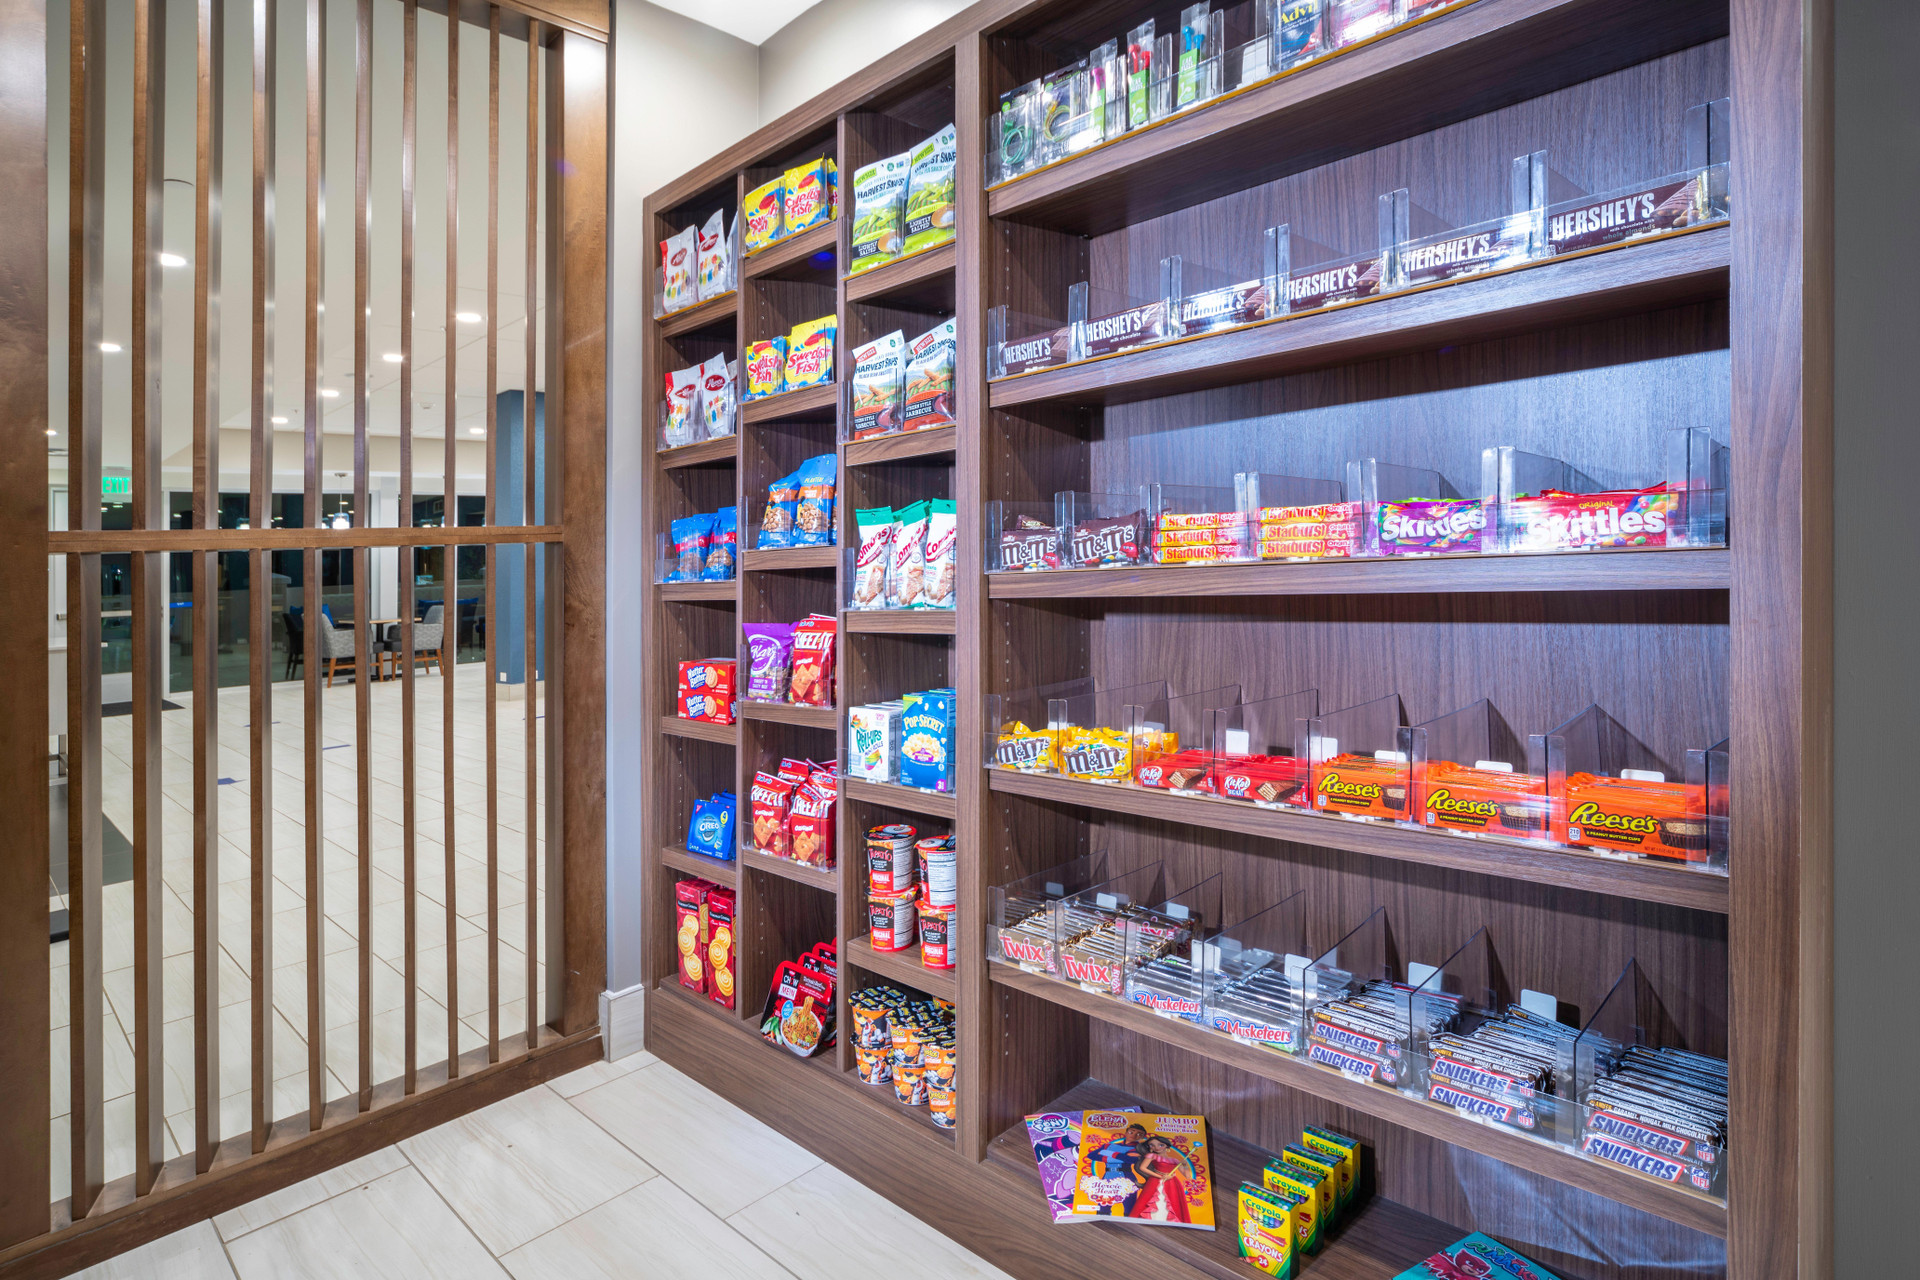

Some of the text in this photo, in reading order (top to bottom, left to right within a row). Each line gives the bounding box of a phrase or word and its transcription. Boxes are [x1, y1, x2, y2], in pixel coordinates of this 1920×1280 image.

[857, 182, 886, 198] HARVEST
[1552, 192, 1655, 240] HERSHEY'S
[1621, 221, 1643, 230] chocolate
[1602, 224, 1656, 241] whole almonds
[1404, 234, 1490, 272] HERSHEY'S
[1285, 266, 1357, 300] HERSHEY'S
[1086, 310, 1142, 342] HERSHEY'S
[1005, 338, 1050, 364] HERSHEY'S
[796, 360, 820, 375] Fish
[857, 360, 885, 374] HARVEST
[103, 477, 129, 493] EXIT
[1267, 524, 1326, 538] Starburst
[1380, 509, 1487, 542] Skittles
[1526, 508, 1666, 546] Skittles
[1166, 530, 1216, 544] Starburst
[1266, 540, 1325, 554] Starburst
[1166, 545, 1216, 559] Starburst
[687, 666, 705, 678] Nutter
[690, 674, 706, 689] Butter
[686, 695, 703, 707] Nutter
[689, 702, 706, 717] Butter
[872, 741, 884, 750] ROLLS
[1318, 773, 1382, 798] Reese's
[1427, 789, 1499, 816] Reese's
[700, 822, 719, 831] OREO
[1569, 802, 1658, 833] Reese's
[1000, 936, 1045, 963] Twix
[1063, 954, 1110, 984] Twix
[781, 986, 795, 997] MEIN
[1136, 992, 1145, 1004] 3
[1215, 1019, 1291, 1042] 3 Musketeers
[1316, 1024, 1378, 1053] SNICKERS
[1311, 1046, 1396, 1081] SNICKERS NFL
[1435, 1060, 1534, 1096] SNICKERS NFL
[1432, 1087, 1533, 1126] SNICKERS NFL
[1091, 1114, 1124, 1123] ELENA
[1613, 1107, 1708, 1141] CARAMEL, NOUGAT, MILK CHOCOLATE
[1310, 1139, 1344, 1157] Crayola
[1592, 1114, 1715, 1162] SNICKERS NFL
[1290, 1157, 1325, 1176] Crayola
[1587, 1138, 1710, 1189] SNICKERS NFL
[1271, 1176, 1306, 1196] Crayola
[1246, 1199, 1281, 1219] Crayola
[1244, 1236, 1284, 1263] CRAYONS
[1259, 1257, 1268, 1266] 24
